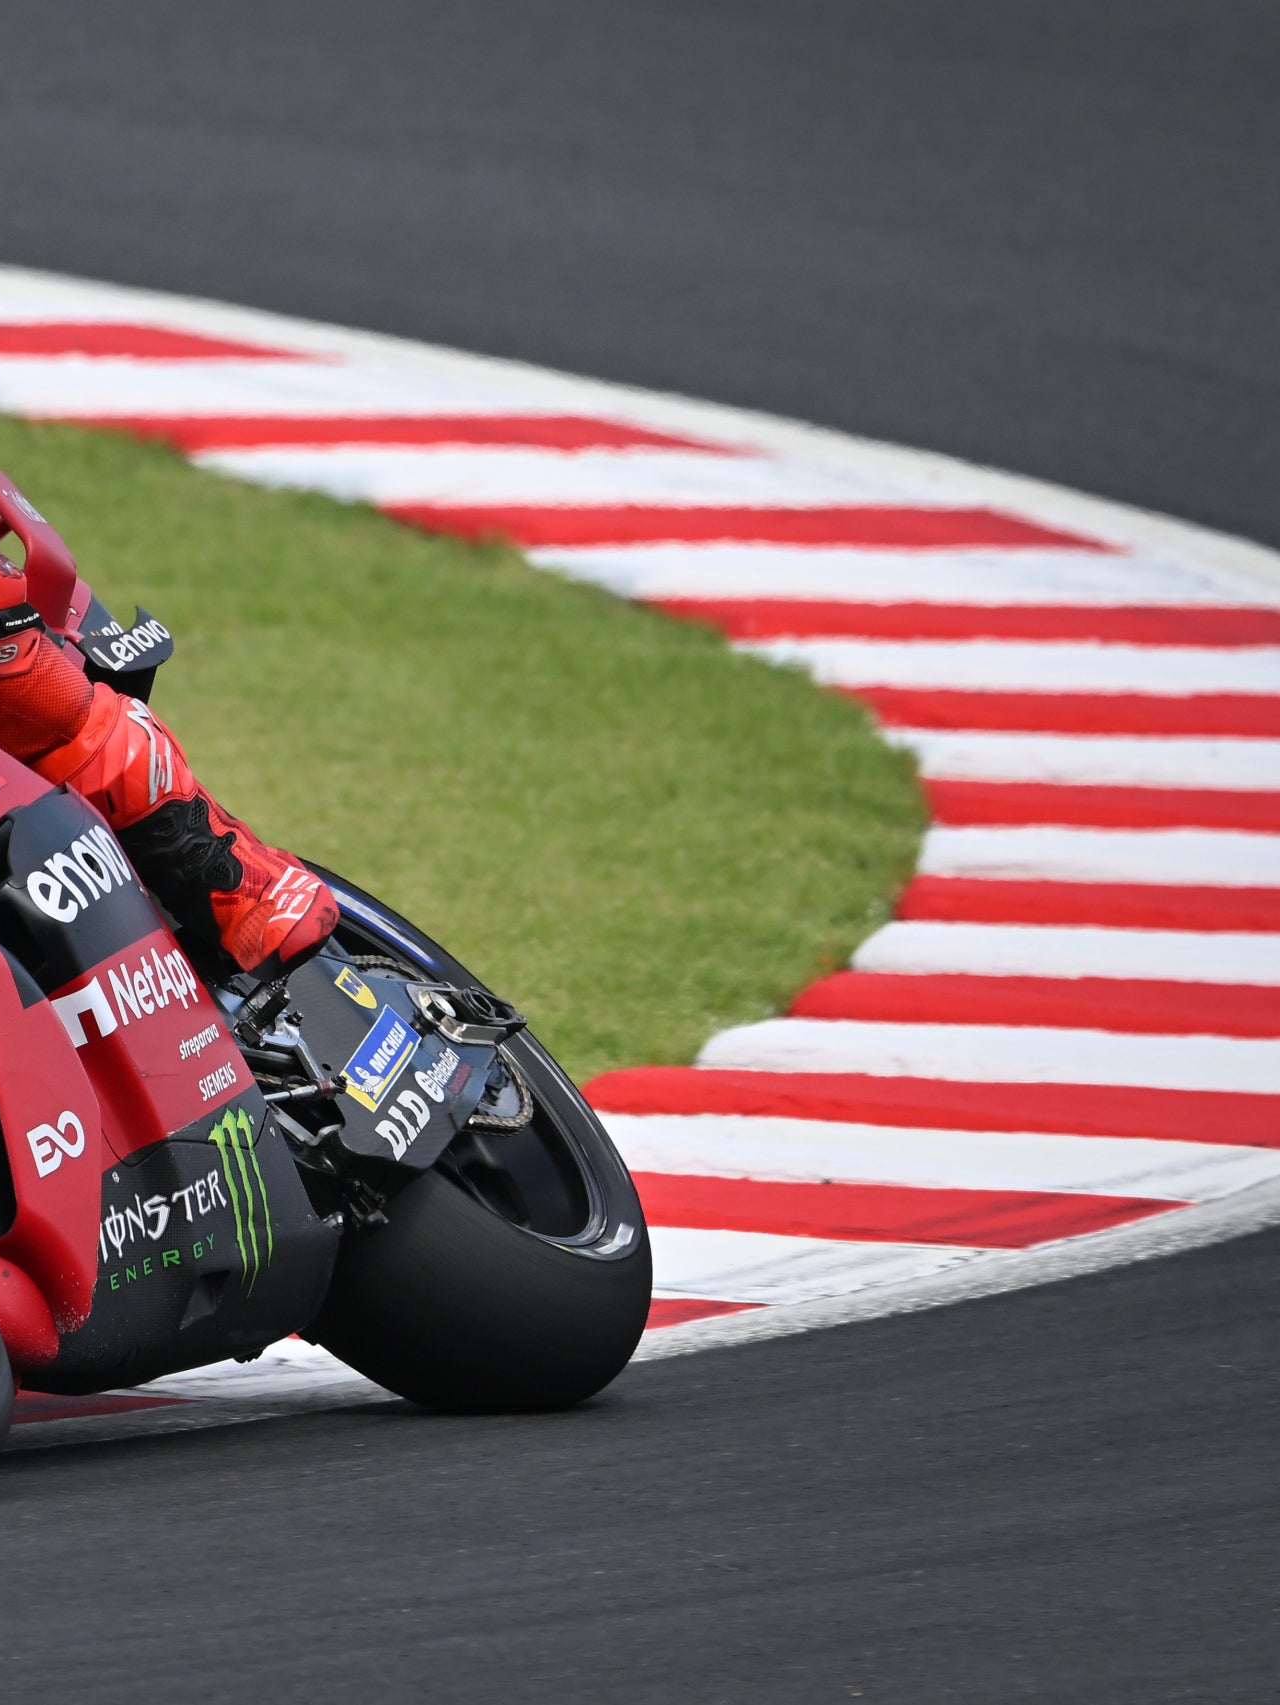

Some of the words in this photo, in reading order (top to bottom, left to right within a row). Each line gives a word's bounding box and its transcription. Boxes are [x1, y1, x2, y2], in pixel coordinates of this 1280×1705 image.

[92, 619, 171, 671] Lenovo
[27, 824, 132, 923] enovo
[108, 948, 200, 1026] NetApp
[179, 1023, 220, 1060] streparava
[199, 1062, 237, 1102] SIEMENS
[110, 1233, 216, 1291] ENERGY
